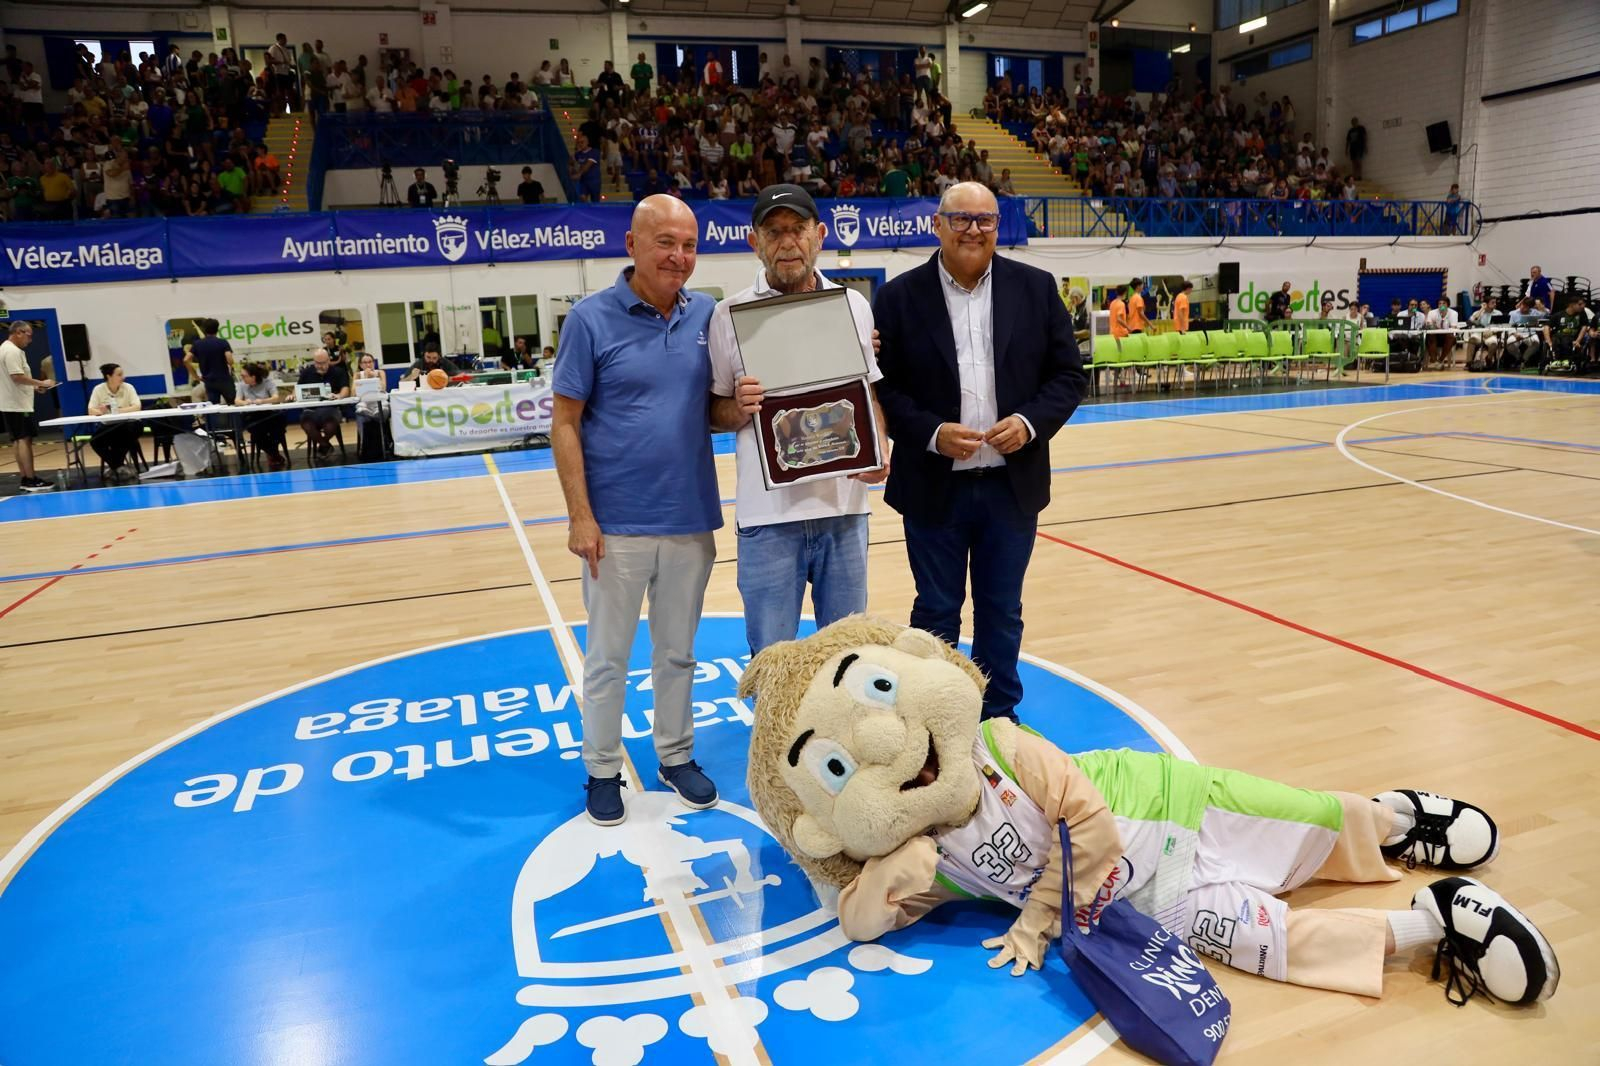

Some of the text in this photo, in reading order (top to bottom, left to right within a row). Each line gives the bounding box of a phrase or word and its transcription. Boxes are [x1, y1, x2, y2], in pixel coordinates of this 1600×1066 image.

[7, 242, 163, 270] Vélez-Málaga
[281, 225, 605, 263] Ayuntamiento Vélez-Málaga
[218, 316, 314, 344] deportes
[402, 390, 553, 436] deportes
[174, 762, 304, 812] de
[972, 822, 1032, 884] 32
[1453, 894, 1492, 917] FLM
[1129, 926, 1173, 971] CLINICA
[1188, 910, 1236, 966] 32
[1204, 1019, 1226, 1042] 900
